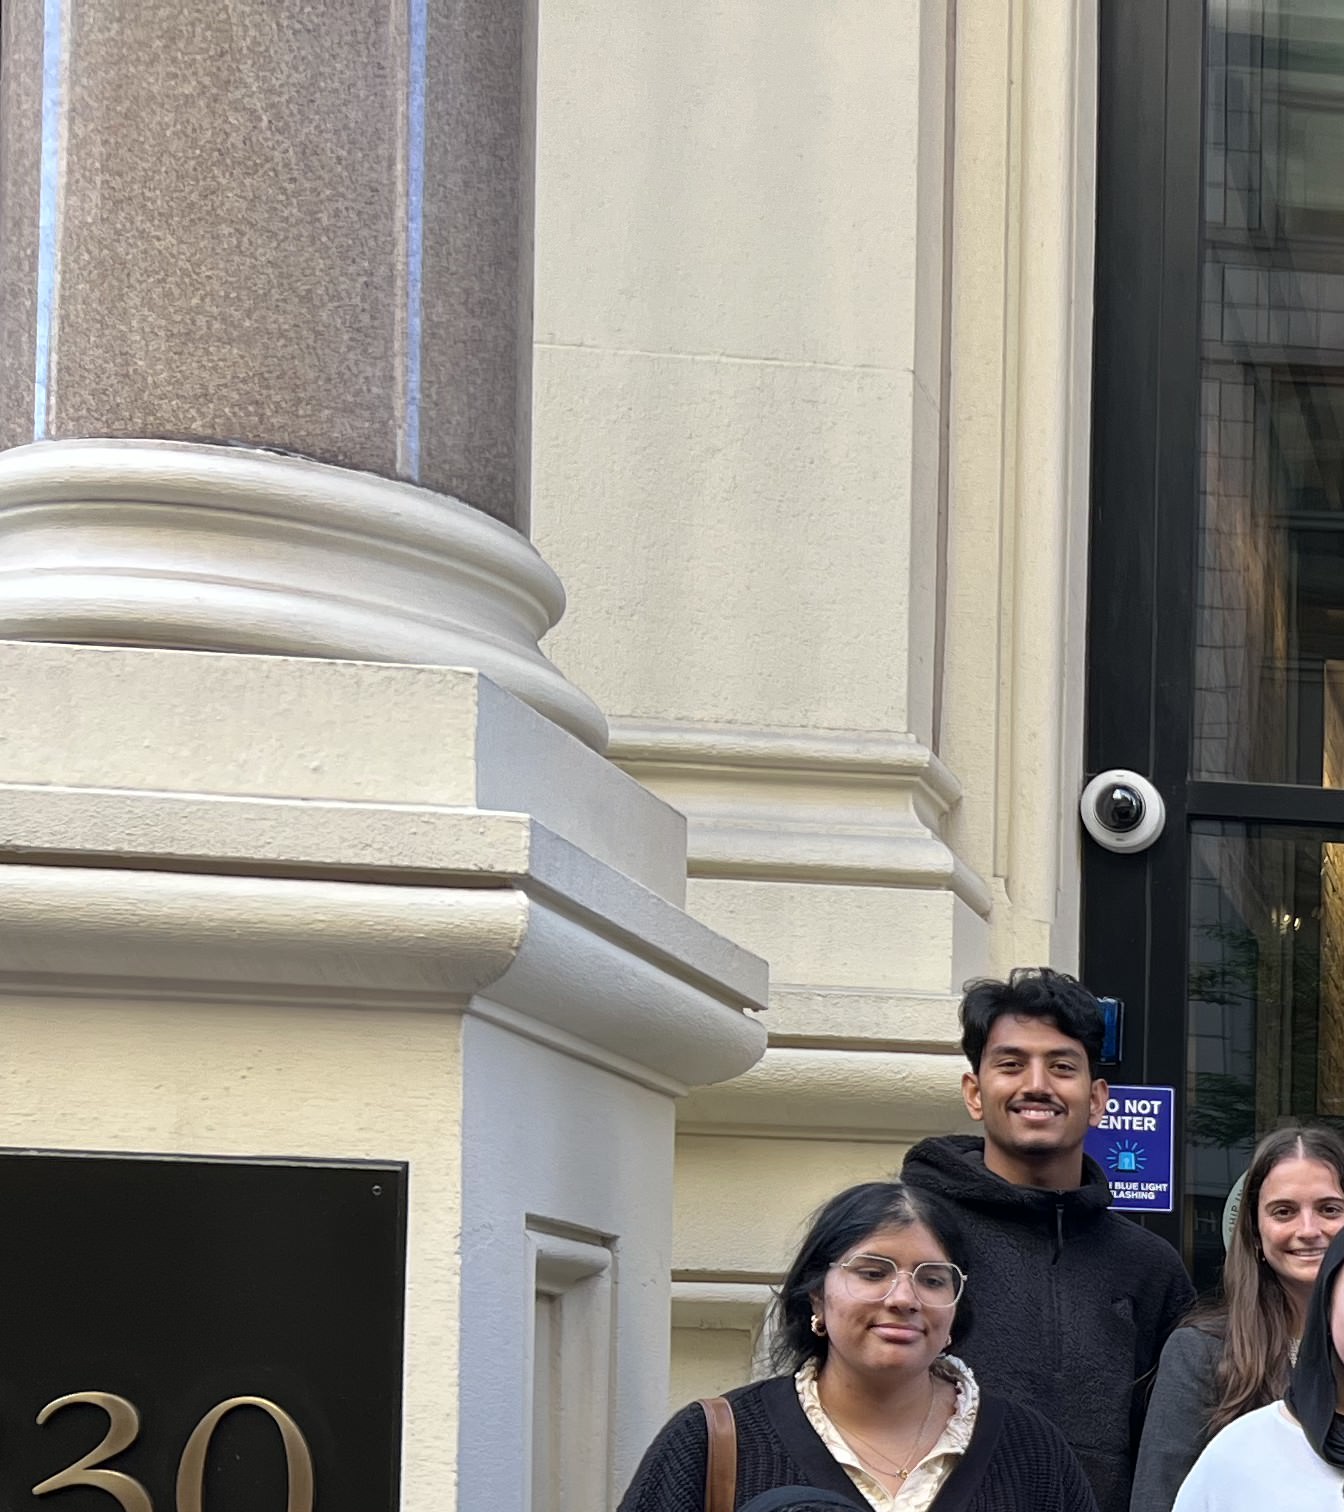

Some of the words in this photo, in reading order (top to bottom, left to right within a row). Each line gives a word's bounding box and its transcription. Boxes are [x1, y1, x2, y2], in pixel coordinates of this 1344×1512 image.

[1106, 1098, 1120, 1113] O
[1125, 1100, 1162, 1115] NOT
[1098, 1115, 1156, 1131] ENTER
[1114, 1182, 1139, 1190] BLUE
[1140, 1183, 1168, 1192] LIGHT
